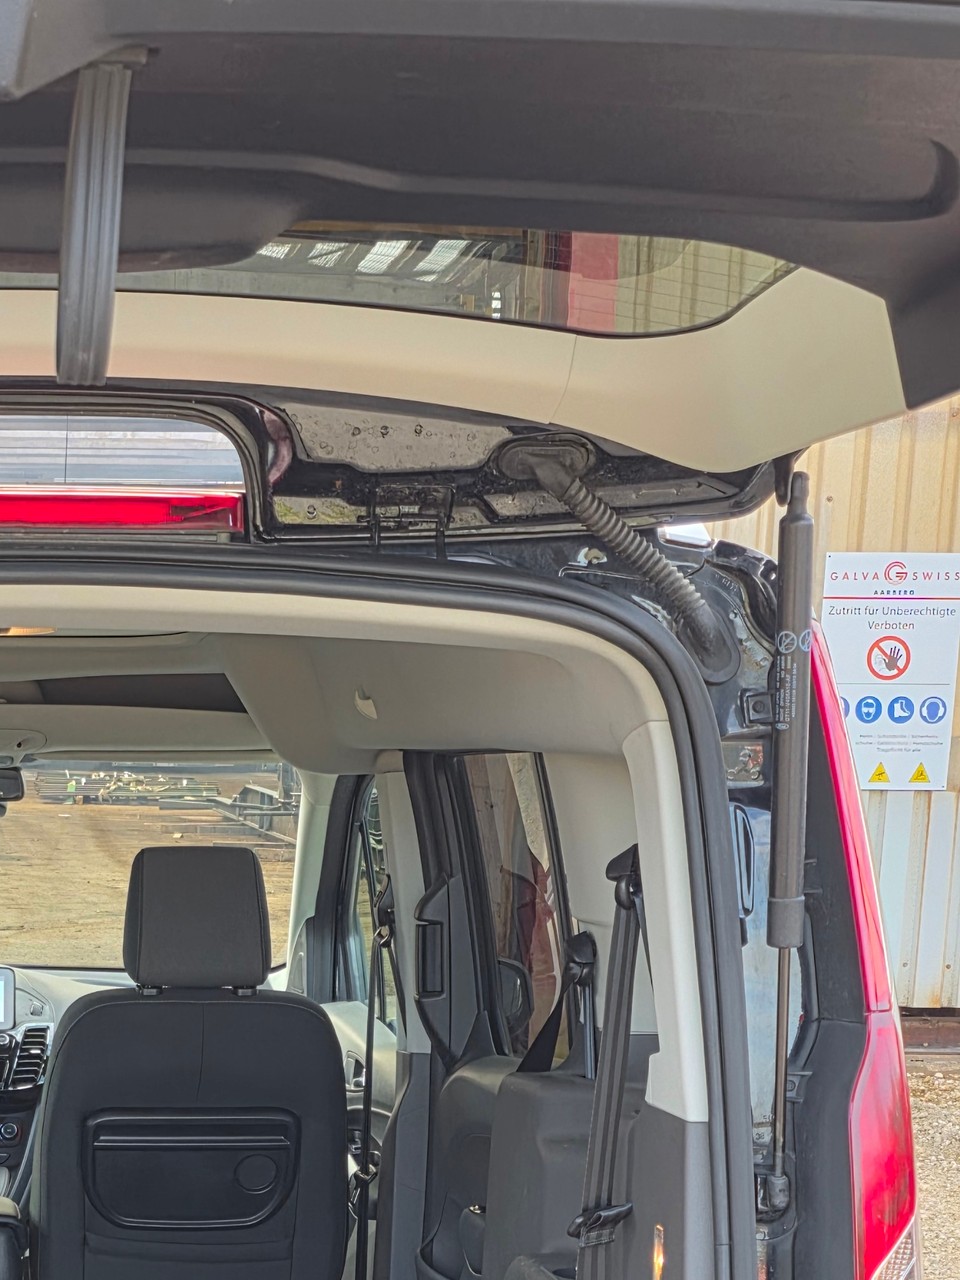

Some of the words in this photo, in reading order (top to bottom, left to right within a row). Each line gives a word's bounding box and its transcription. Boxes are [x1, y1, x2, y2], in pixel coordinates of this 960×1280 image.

[830, 571, 880, 581] GALVA
[912, 571, 960, 581] SWISS
[828, 605, 861, 616] Zutritt
[864, 605, 879, 616] für
[882, 606, 957, 619] Unberechtigte
[867, 620, 916, 630] Verboten
